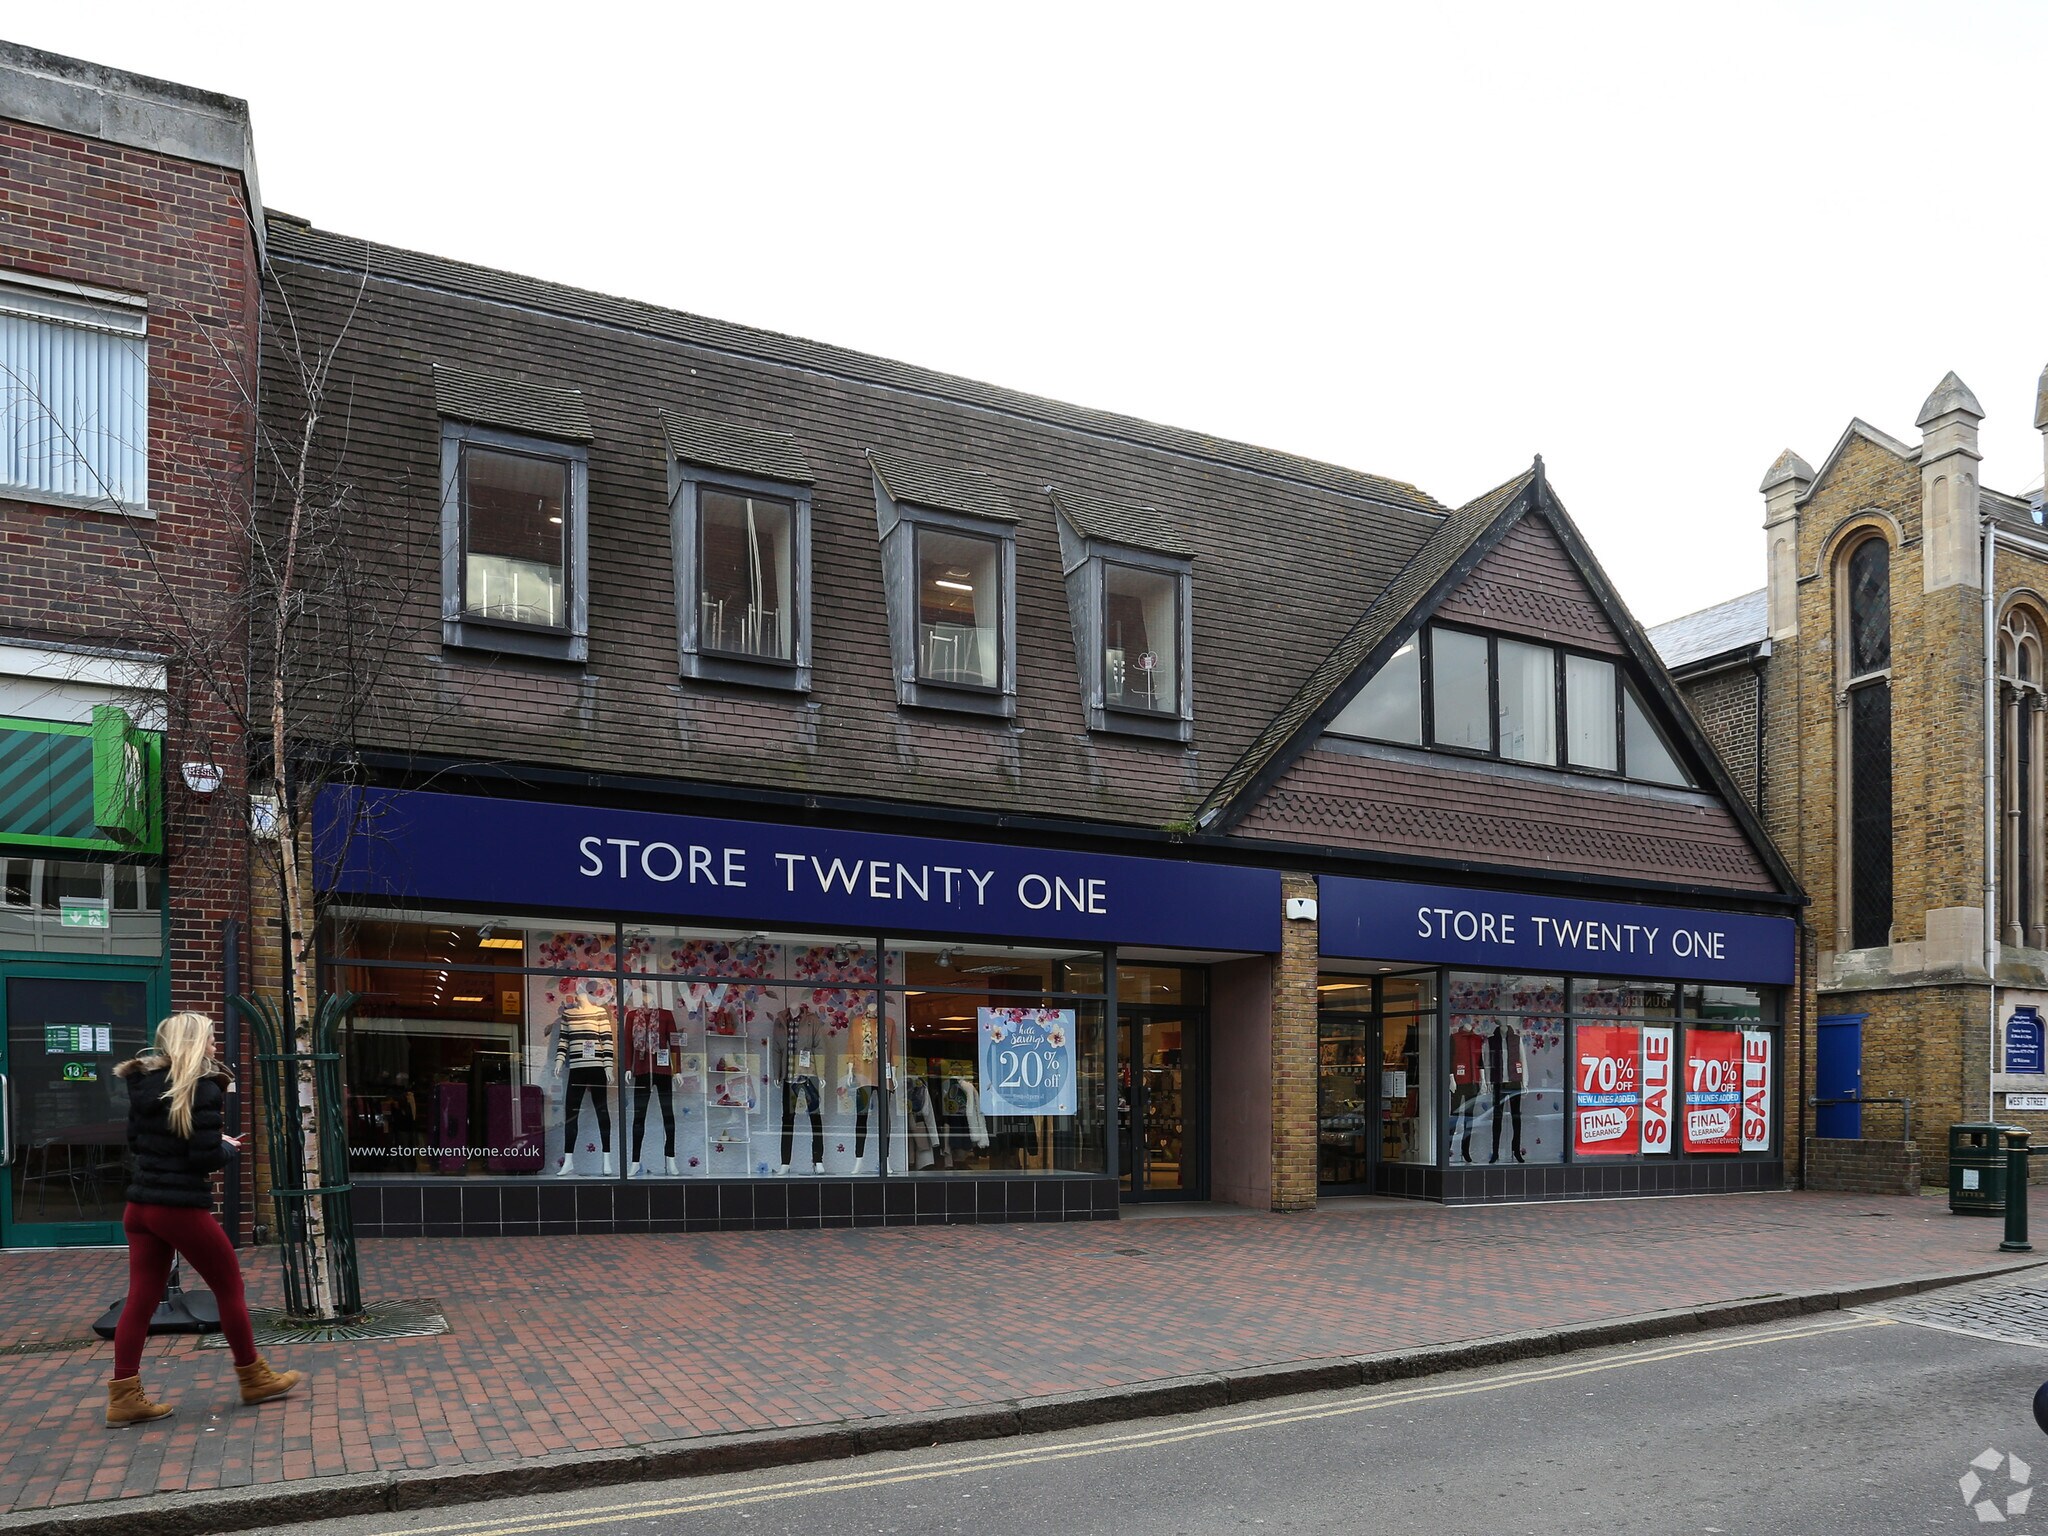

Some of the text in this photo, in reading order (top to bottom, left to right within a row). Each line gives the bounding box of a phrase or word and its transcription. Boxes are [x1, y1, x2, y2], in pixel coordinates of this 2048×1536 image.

[579, 836, 1107, 914] STORE TWENTY ONE
[1417, 907, 1726, 960] STORE TWENTY ONE
[1018, 1023, 1036, 1035] hello
[999, 1051, 1060, 1088] 20%
[1581, 1056, 1634, 1092] 70%
[1689, 1059, 1737, 1092] 70%
[1044, 1074, 1060, 1088] off
[1616, 1081, 1634, 1092] OFF
[1720, 1083, 1736, 1093] OFF
[1644, 1036, 1669, 1144] SALE
[1744, 1039, 1767, 1142] SALE
[1578, 1094, 1636, 1104] NEW LINES ADDED
[1686, 1093, 1739, 1103] NEW LINES ADDED
[2008, 1096, 2047, 1106] WEST STREET
[1584, 1126, 1622, 1139] CLEARANCE
[1691, 1126, 1725, 1137] CLEARANCE
[349, 1145, 540, 1160] www.storetwentyone.co.uk
